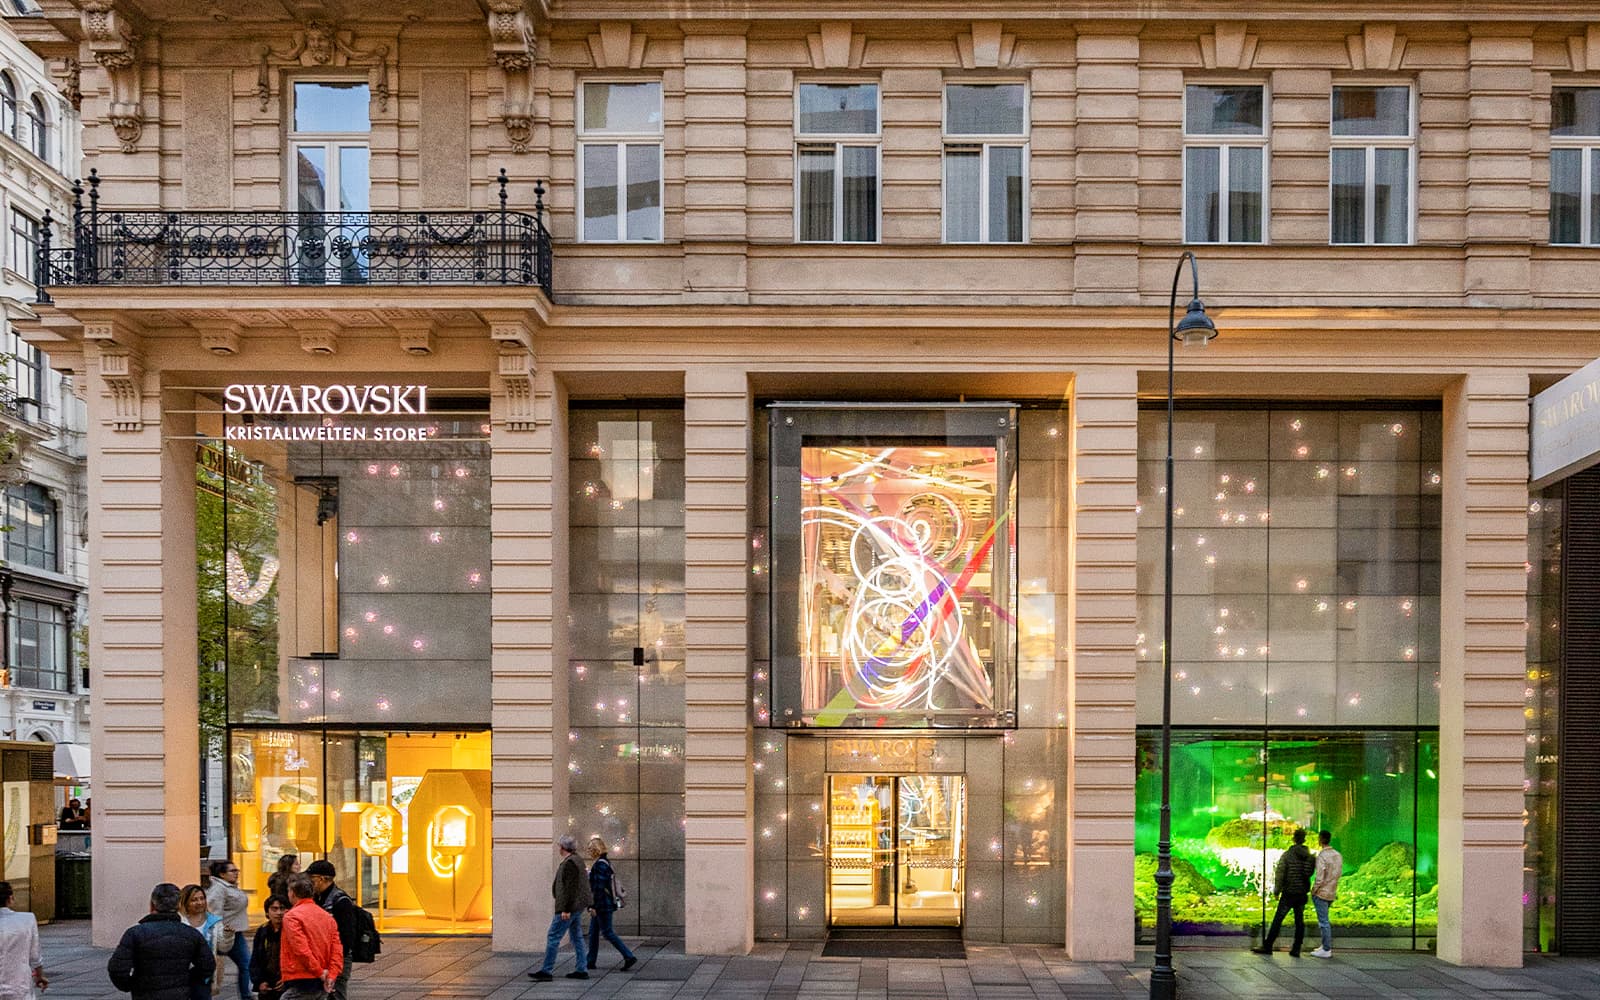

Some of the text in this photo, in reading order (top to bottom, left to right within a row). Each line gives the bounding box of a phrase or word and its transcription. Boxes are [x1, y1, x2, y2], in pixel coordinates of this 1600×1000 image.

[224, 384, 428, 414] SWAROVSKI
[226, 426, 427, 441] KRISTALLWELTEN STORE
